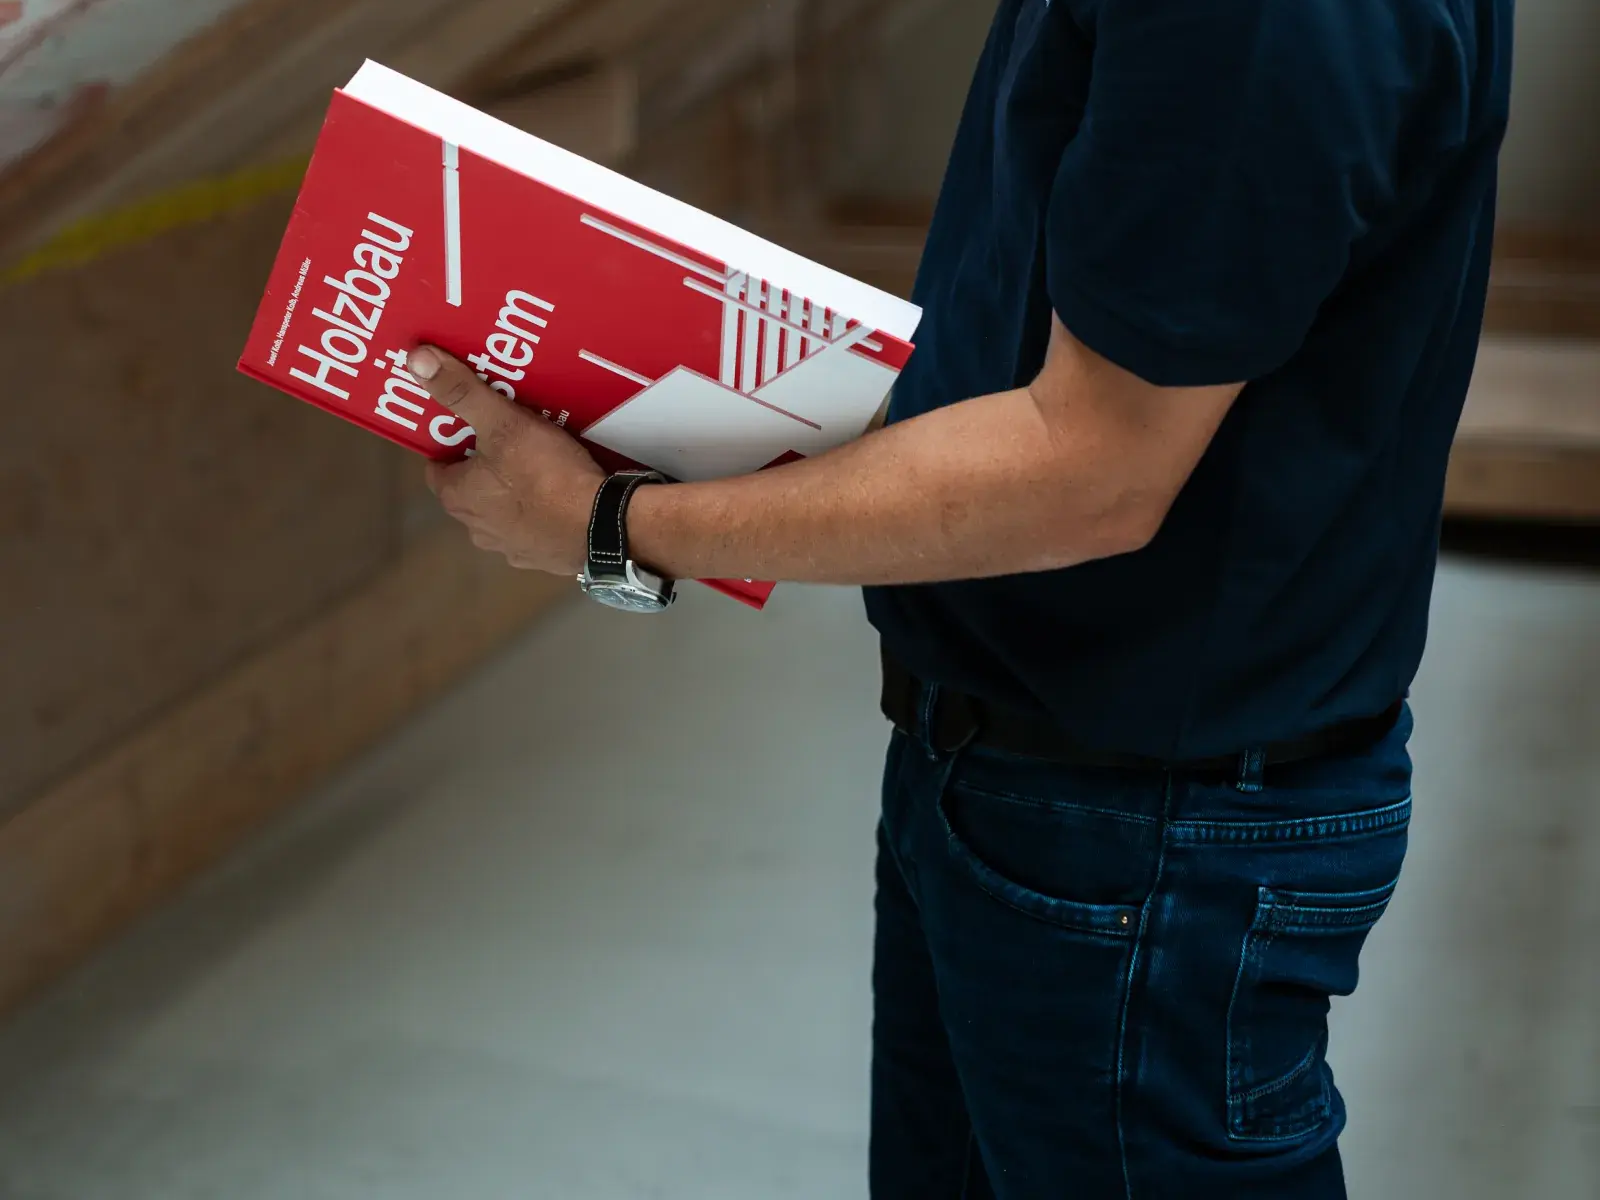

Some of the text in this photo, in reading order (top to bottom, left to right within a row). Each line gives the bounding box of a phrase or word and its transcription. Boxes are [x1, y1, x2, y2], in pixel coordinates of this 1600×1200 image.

[291, 275, 305, 298] Andreas
[286, 298, 299, 312] Kolb,
[289, 211, 414, 400] Holzbau
[271, 339, 284, 353] Kolb,
[267, 351, 277, 366] Josef
[428, 289, 556, 458] Stem
